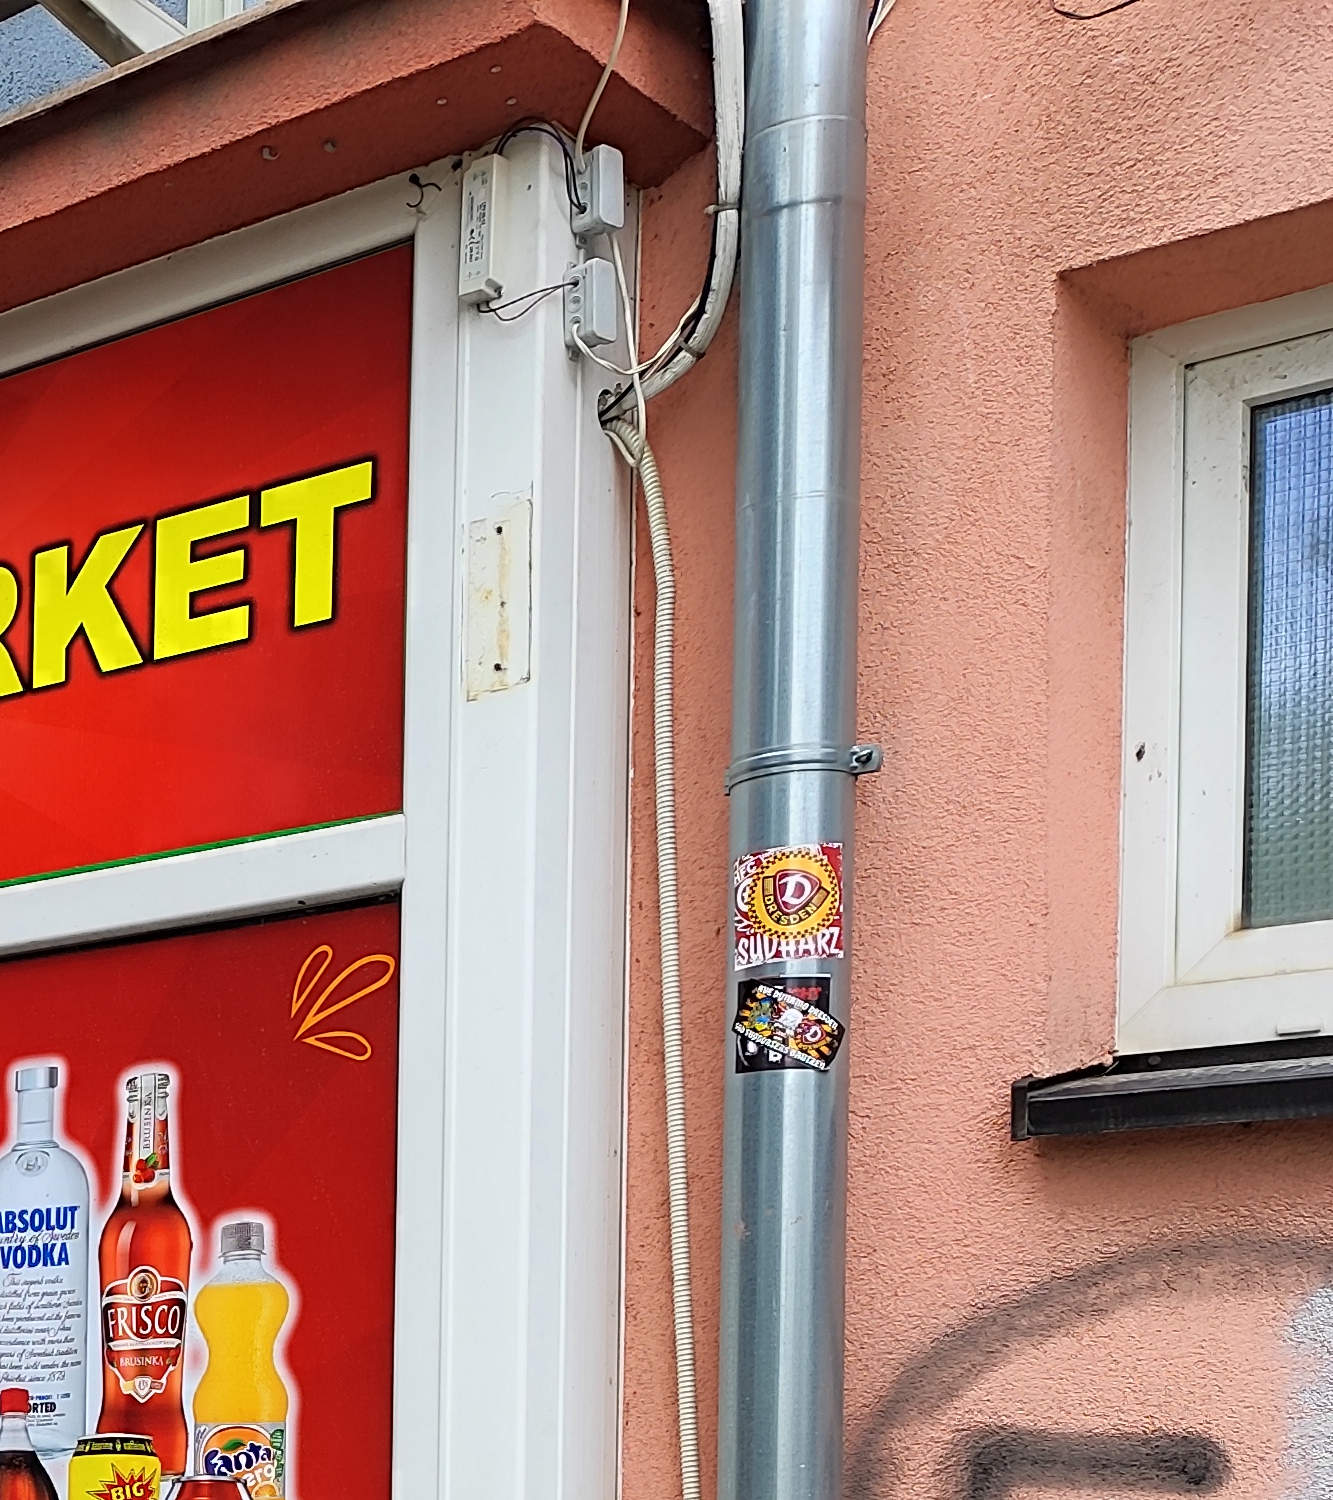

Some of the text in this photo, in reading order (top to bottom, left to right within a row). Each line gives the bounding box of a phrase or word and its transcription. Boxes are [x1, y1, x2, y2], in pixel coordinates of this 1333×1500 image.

[765, 896, 818, 925] DRESDEN
[143, 1092, 152, 1149] BRUSINKA
[0, 1242, 69, 1269] VODKA
[108, 1305, 180, 1342] FRISCO
[120, 1356, 163, 1366] BRUSINKA
[27, 1402, 57, 1413] ORTED
